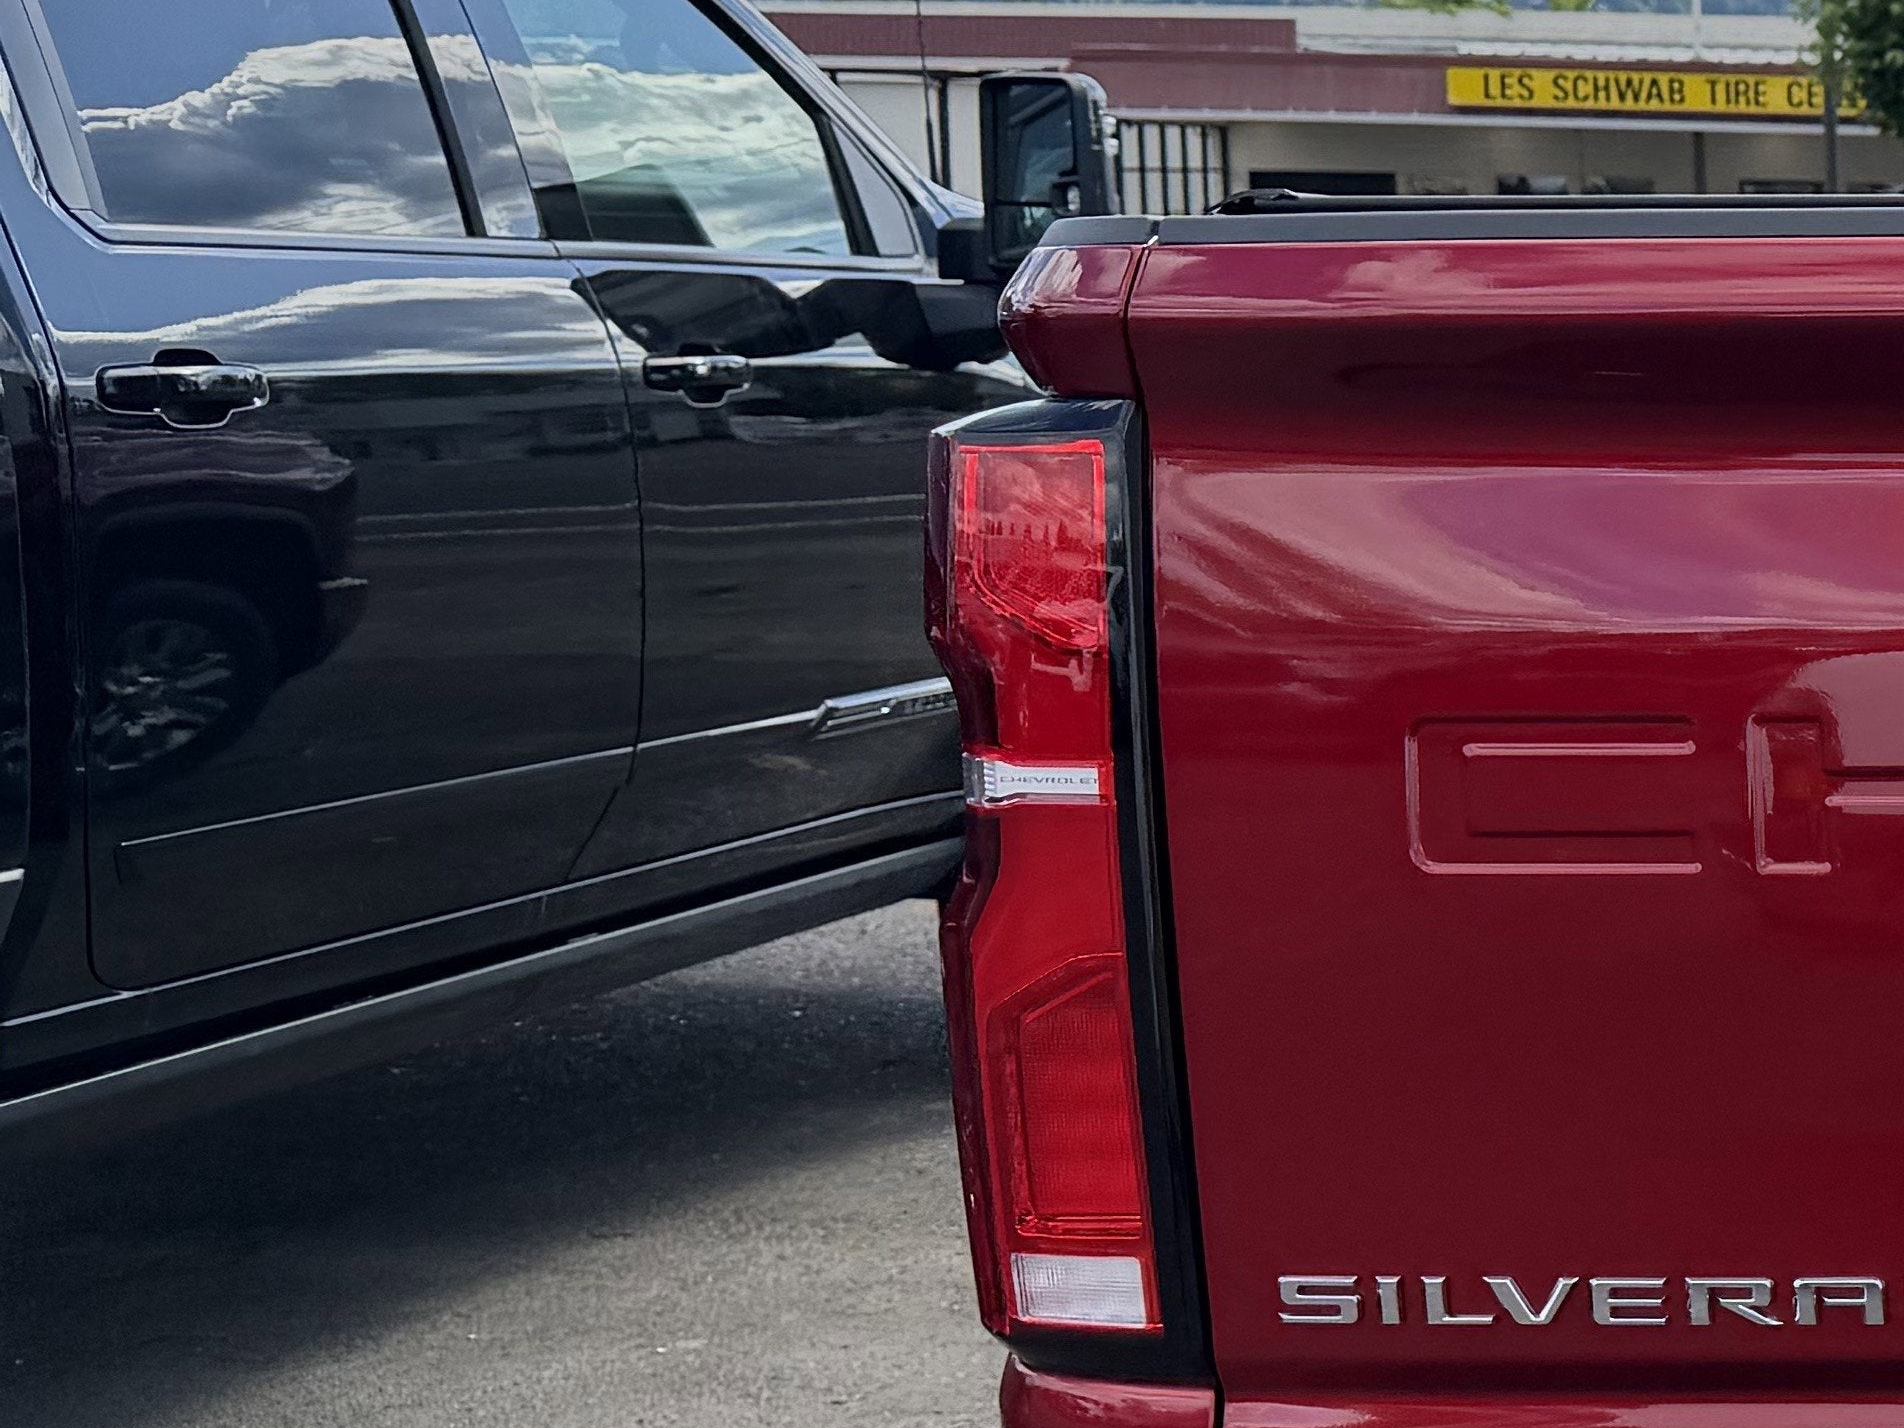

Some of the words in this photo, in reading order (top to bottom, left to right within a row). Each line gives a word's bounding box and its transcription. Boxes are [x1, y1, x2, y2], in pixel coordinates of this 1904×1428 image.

[1482, 71, 1534, 102] LES
[1552, 73, 1687, 106] SCHWAB
[1704, 77, 1769, 108] TIRE
